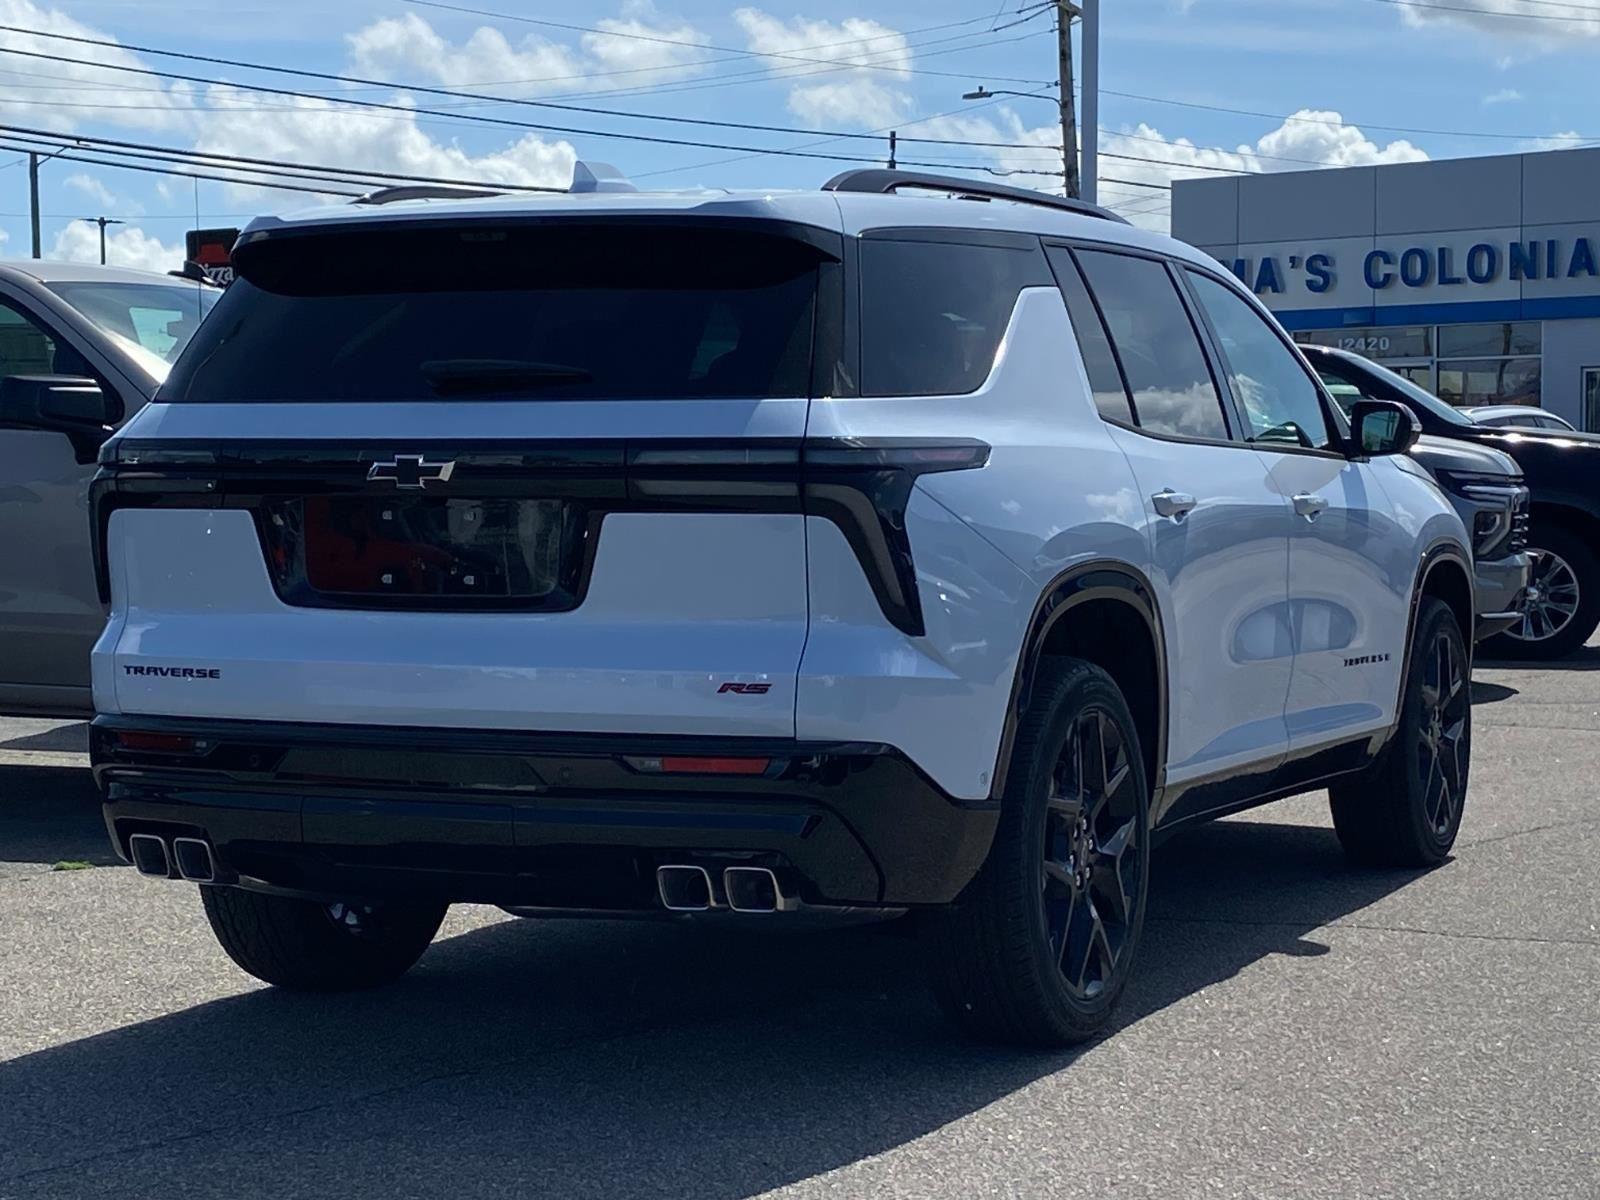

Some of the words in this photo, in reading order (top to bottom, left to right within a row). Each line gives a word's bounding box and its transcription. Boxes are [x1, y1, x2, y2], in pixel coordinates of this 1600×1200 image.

[203, 263, 234, 285] izza
[1338, 337, 1390, 351] 12420
[123, 665, 221, 679] TRAVERSE
[717, 683, 773, 694] RS
